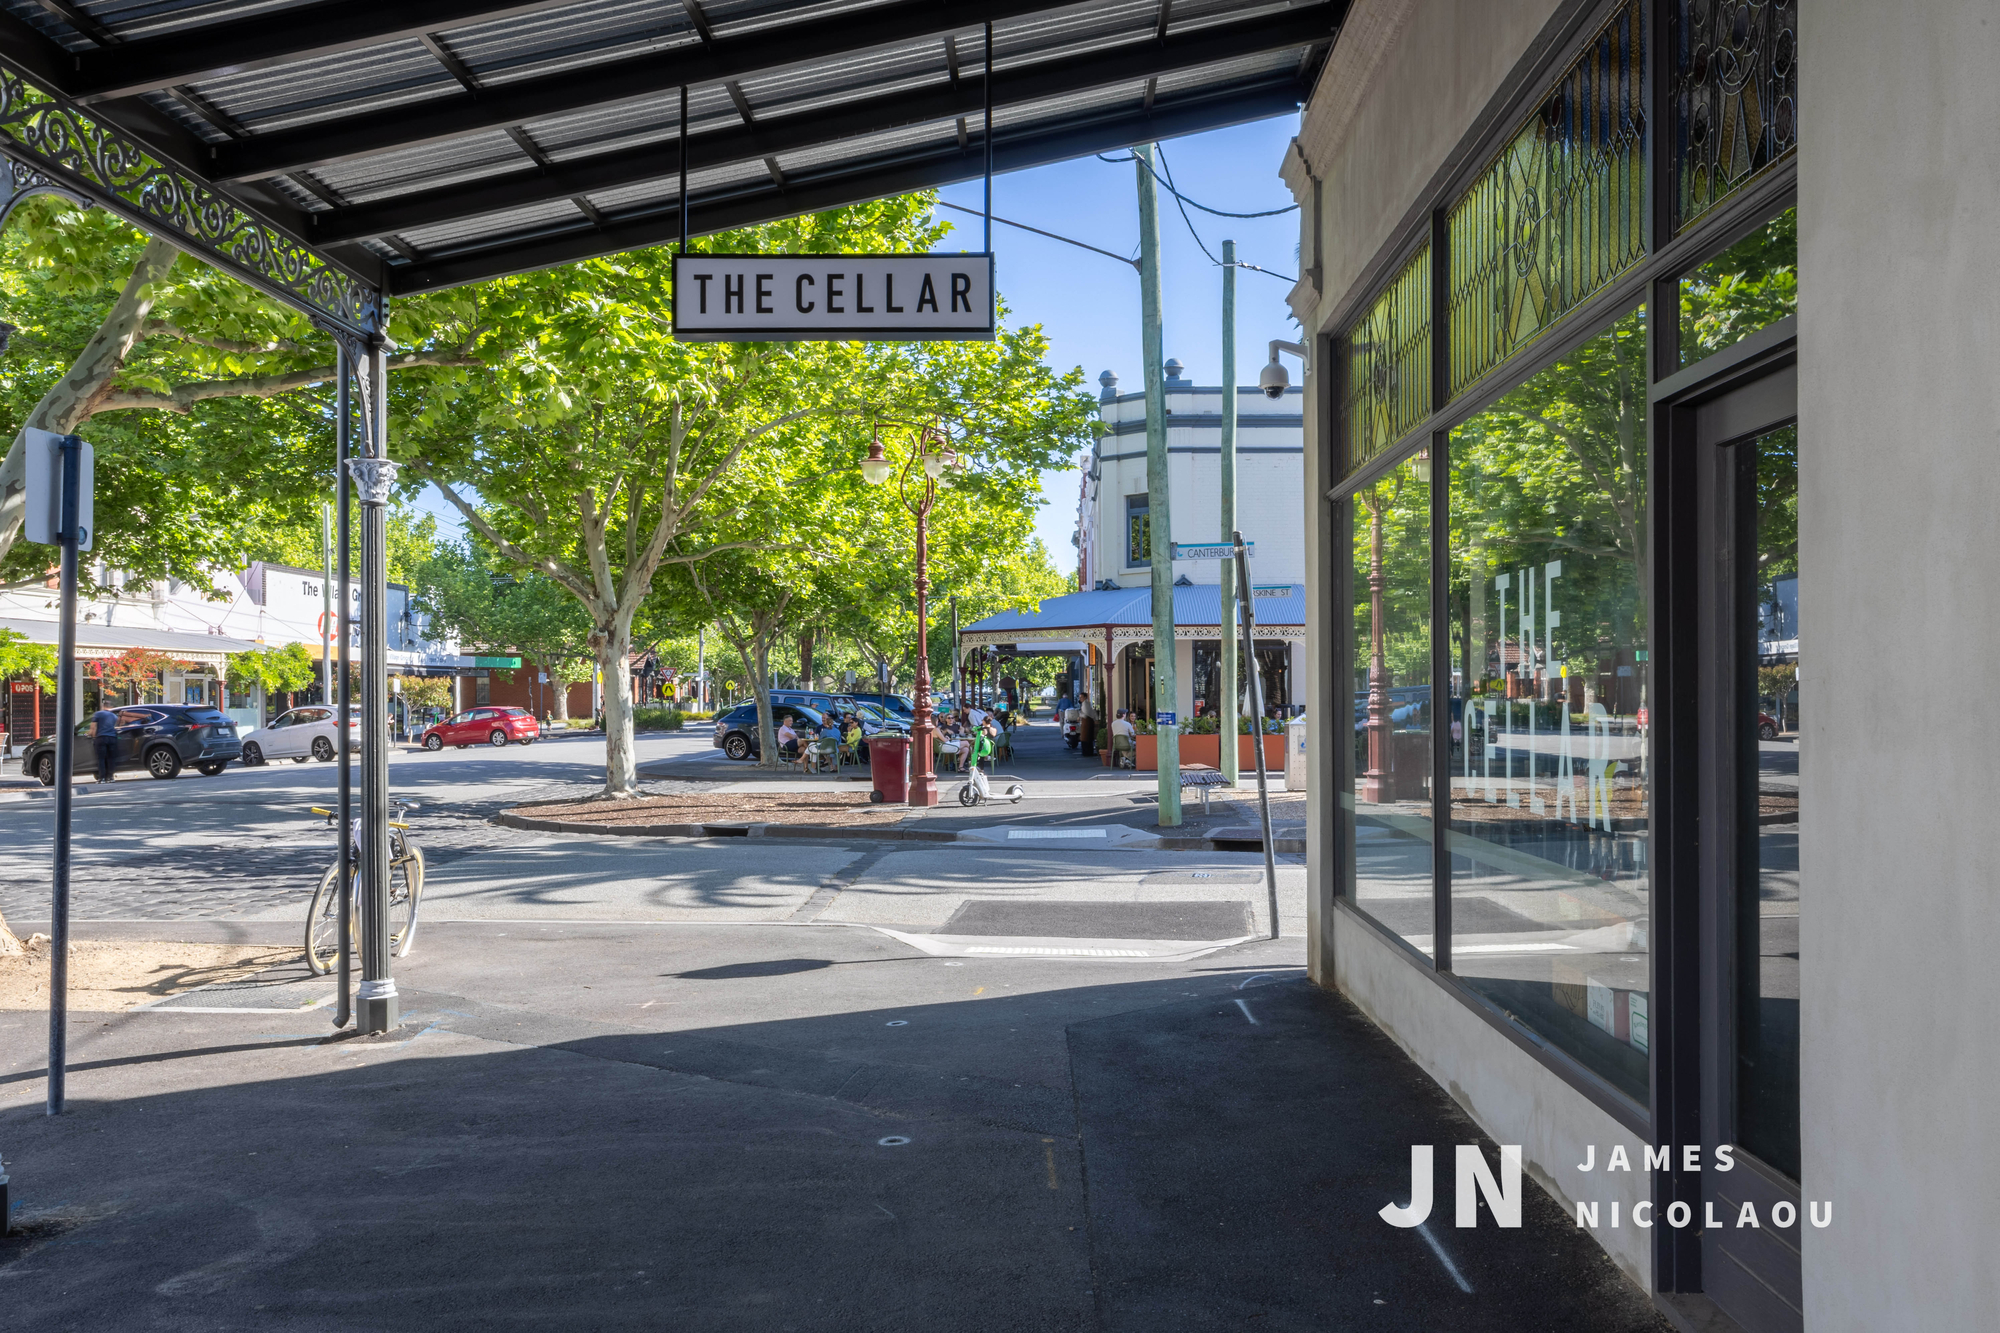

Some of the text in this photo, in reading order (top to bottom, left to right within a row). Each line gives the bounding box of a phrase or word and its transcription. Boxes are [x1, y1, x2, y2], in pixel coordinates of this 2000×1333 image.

[693, 272, 972, 314] THE CELLAR
[1187, 546, 1235, 558] CANTERBUR
[302, 580, 318, 597] The
[1253, 588, 1290, 597] RSKINE ST
[1495, 559, 1562, 679] THE
[1464, 699, 1611, 832] CELLAR
